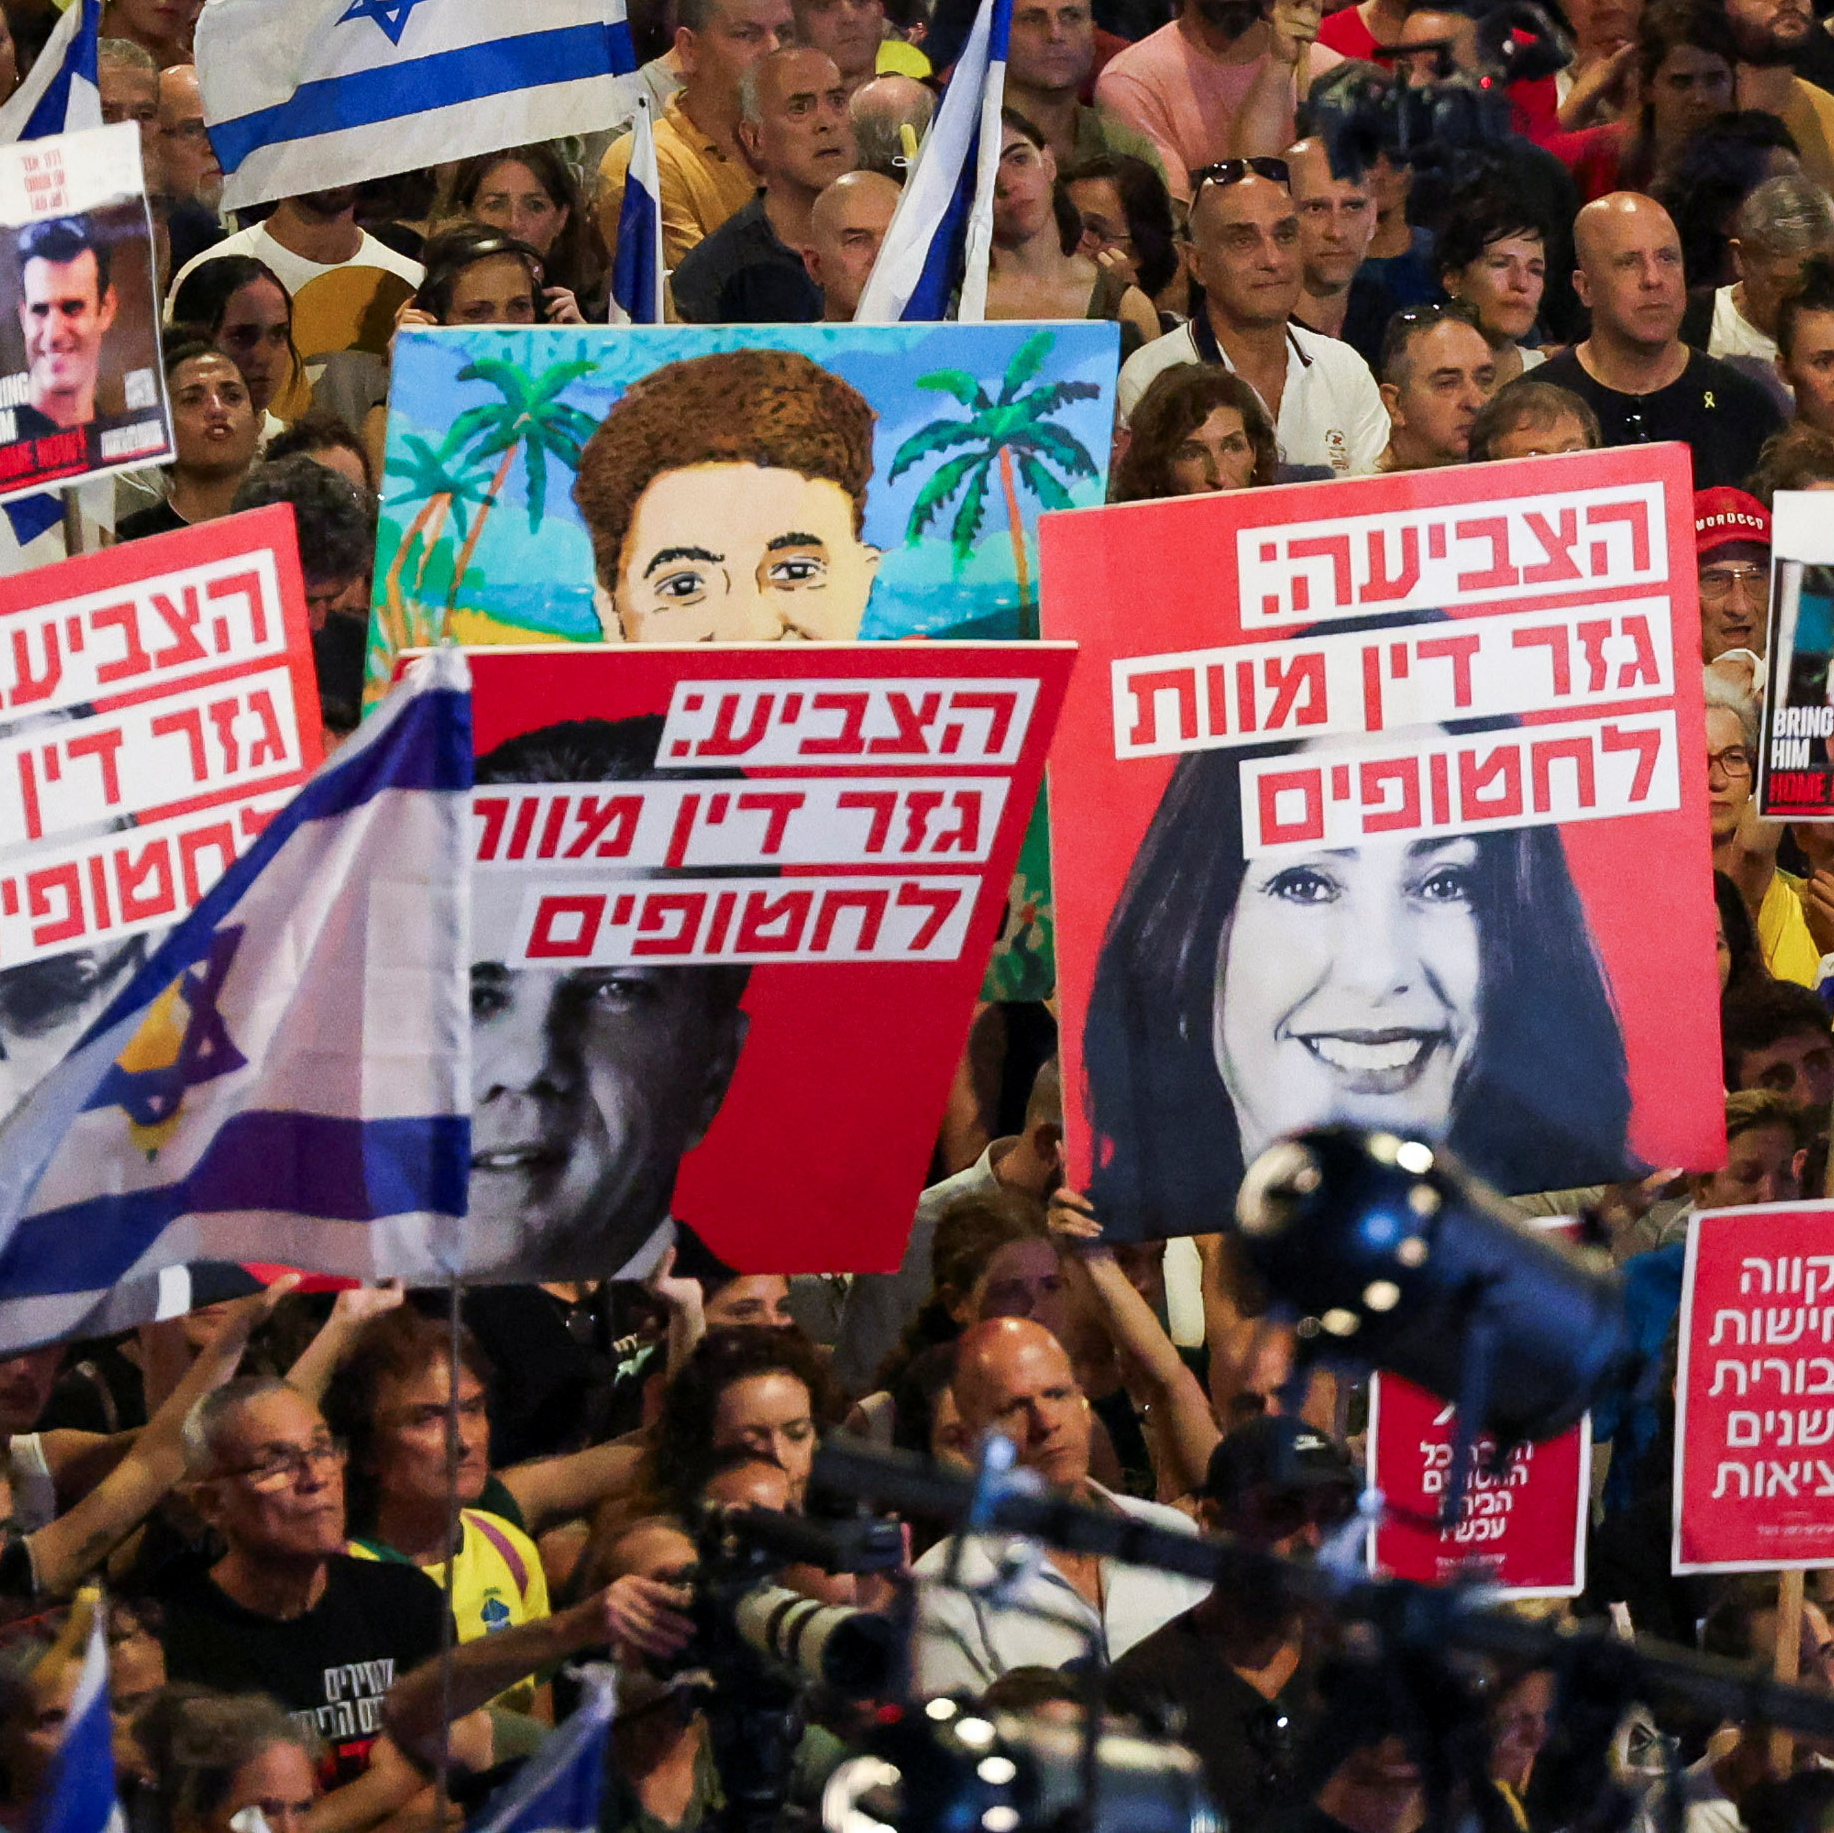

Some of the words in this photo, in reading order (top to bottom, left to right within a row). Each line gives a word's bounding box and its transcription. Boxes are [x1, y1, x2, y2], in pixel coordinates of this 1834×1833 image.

[1259, 500, 1651, 615] הצביעה:
[1695, 512, 1765, 532] MOROCCO
[1362, 633, 1480, 732] דין
[1512, 614, 1661, 697] גזר
[151, 688, 288, 784] גזר
[670, 692, 1019, 758] הצביע:
[1126, 652, 1328, 746] מוות
[1772, 705, 1834, 739] BRING
[16, 727, 122, 841] דין
[1257, 724, 1662, 846] לחטופים
[1770, 737, 1811, 770] HIM
[663, 792, 806, 869] דין
[836, 791, 983, 854] גזר
[525, 883, 962, 959] לחטופים
